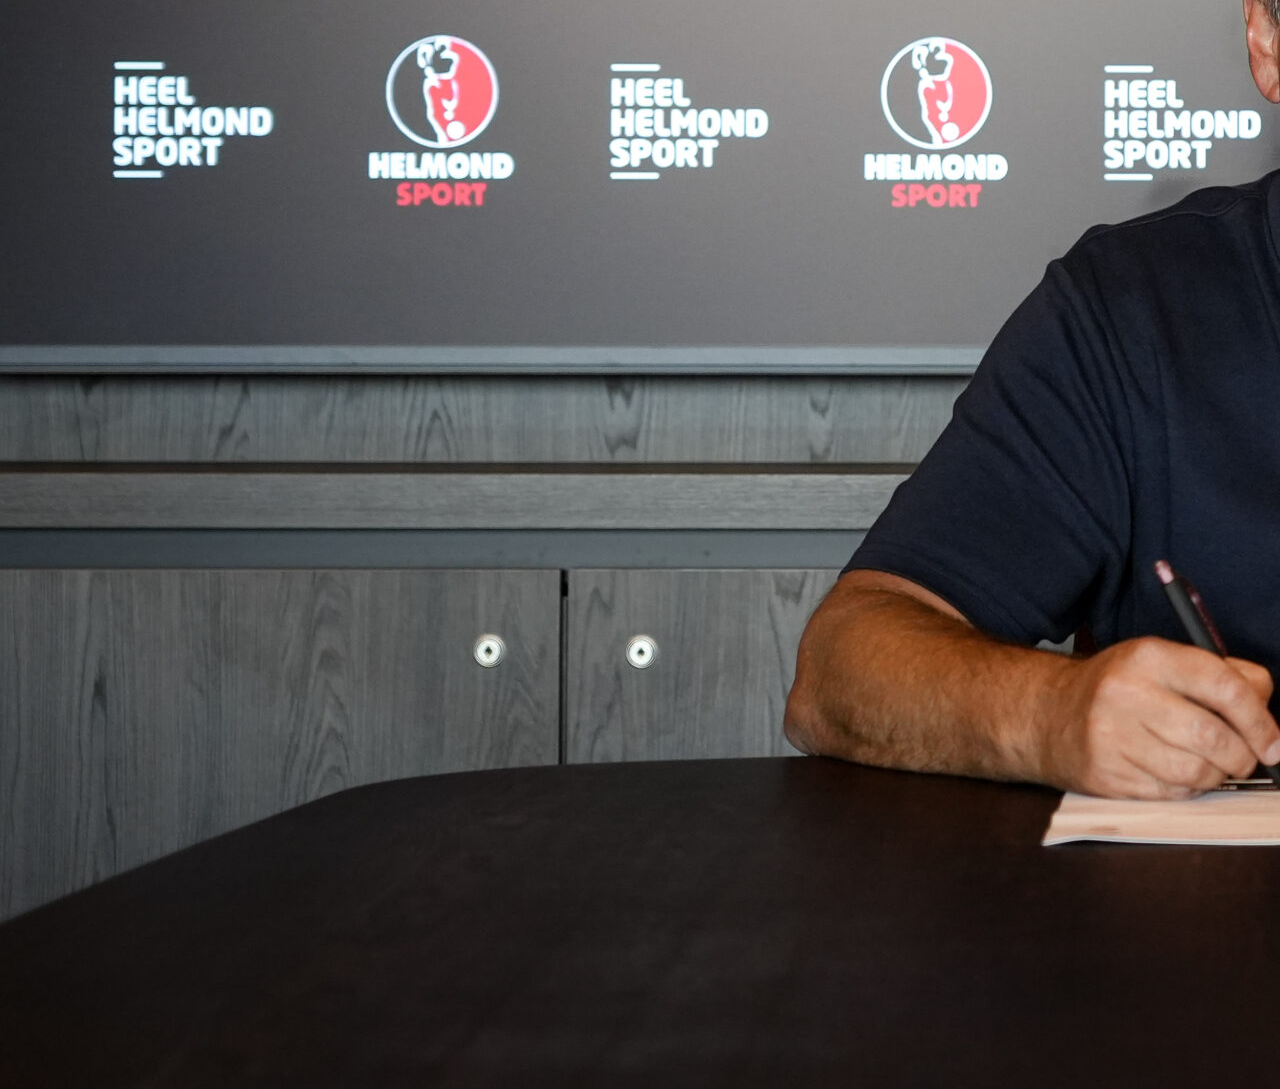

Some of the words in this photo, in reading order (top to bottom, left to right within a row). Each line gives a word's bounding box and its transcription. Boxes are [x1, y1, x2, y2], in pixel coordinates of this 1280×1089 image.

[114, 76, 194, 106] HEEL
[610, 77, 692, 108] HEEL
[1103, 79, 1185, 109] HEEL
[114, 106, 273, 137] HELMOND
[610, 108, 769, 138] HELMOND
[1103, 109, 1262, 140] HELMOND
[112, 136, 223, 167] SPORT
[368, 152, 515, 180] HELMOND
[609, 137, 720, 168] SPORT
[1102, 139, 1213, 170] SPORT
[863, 153, 1009, 181] HELMOND
[396, 181, 488, 207] SPORT
[891, 183, 983, 208] SPORT
